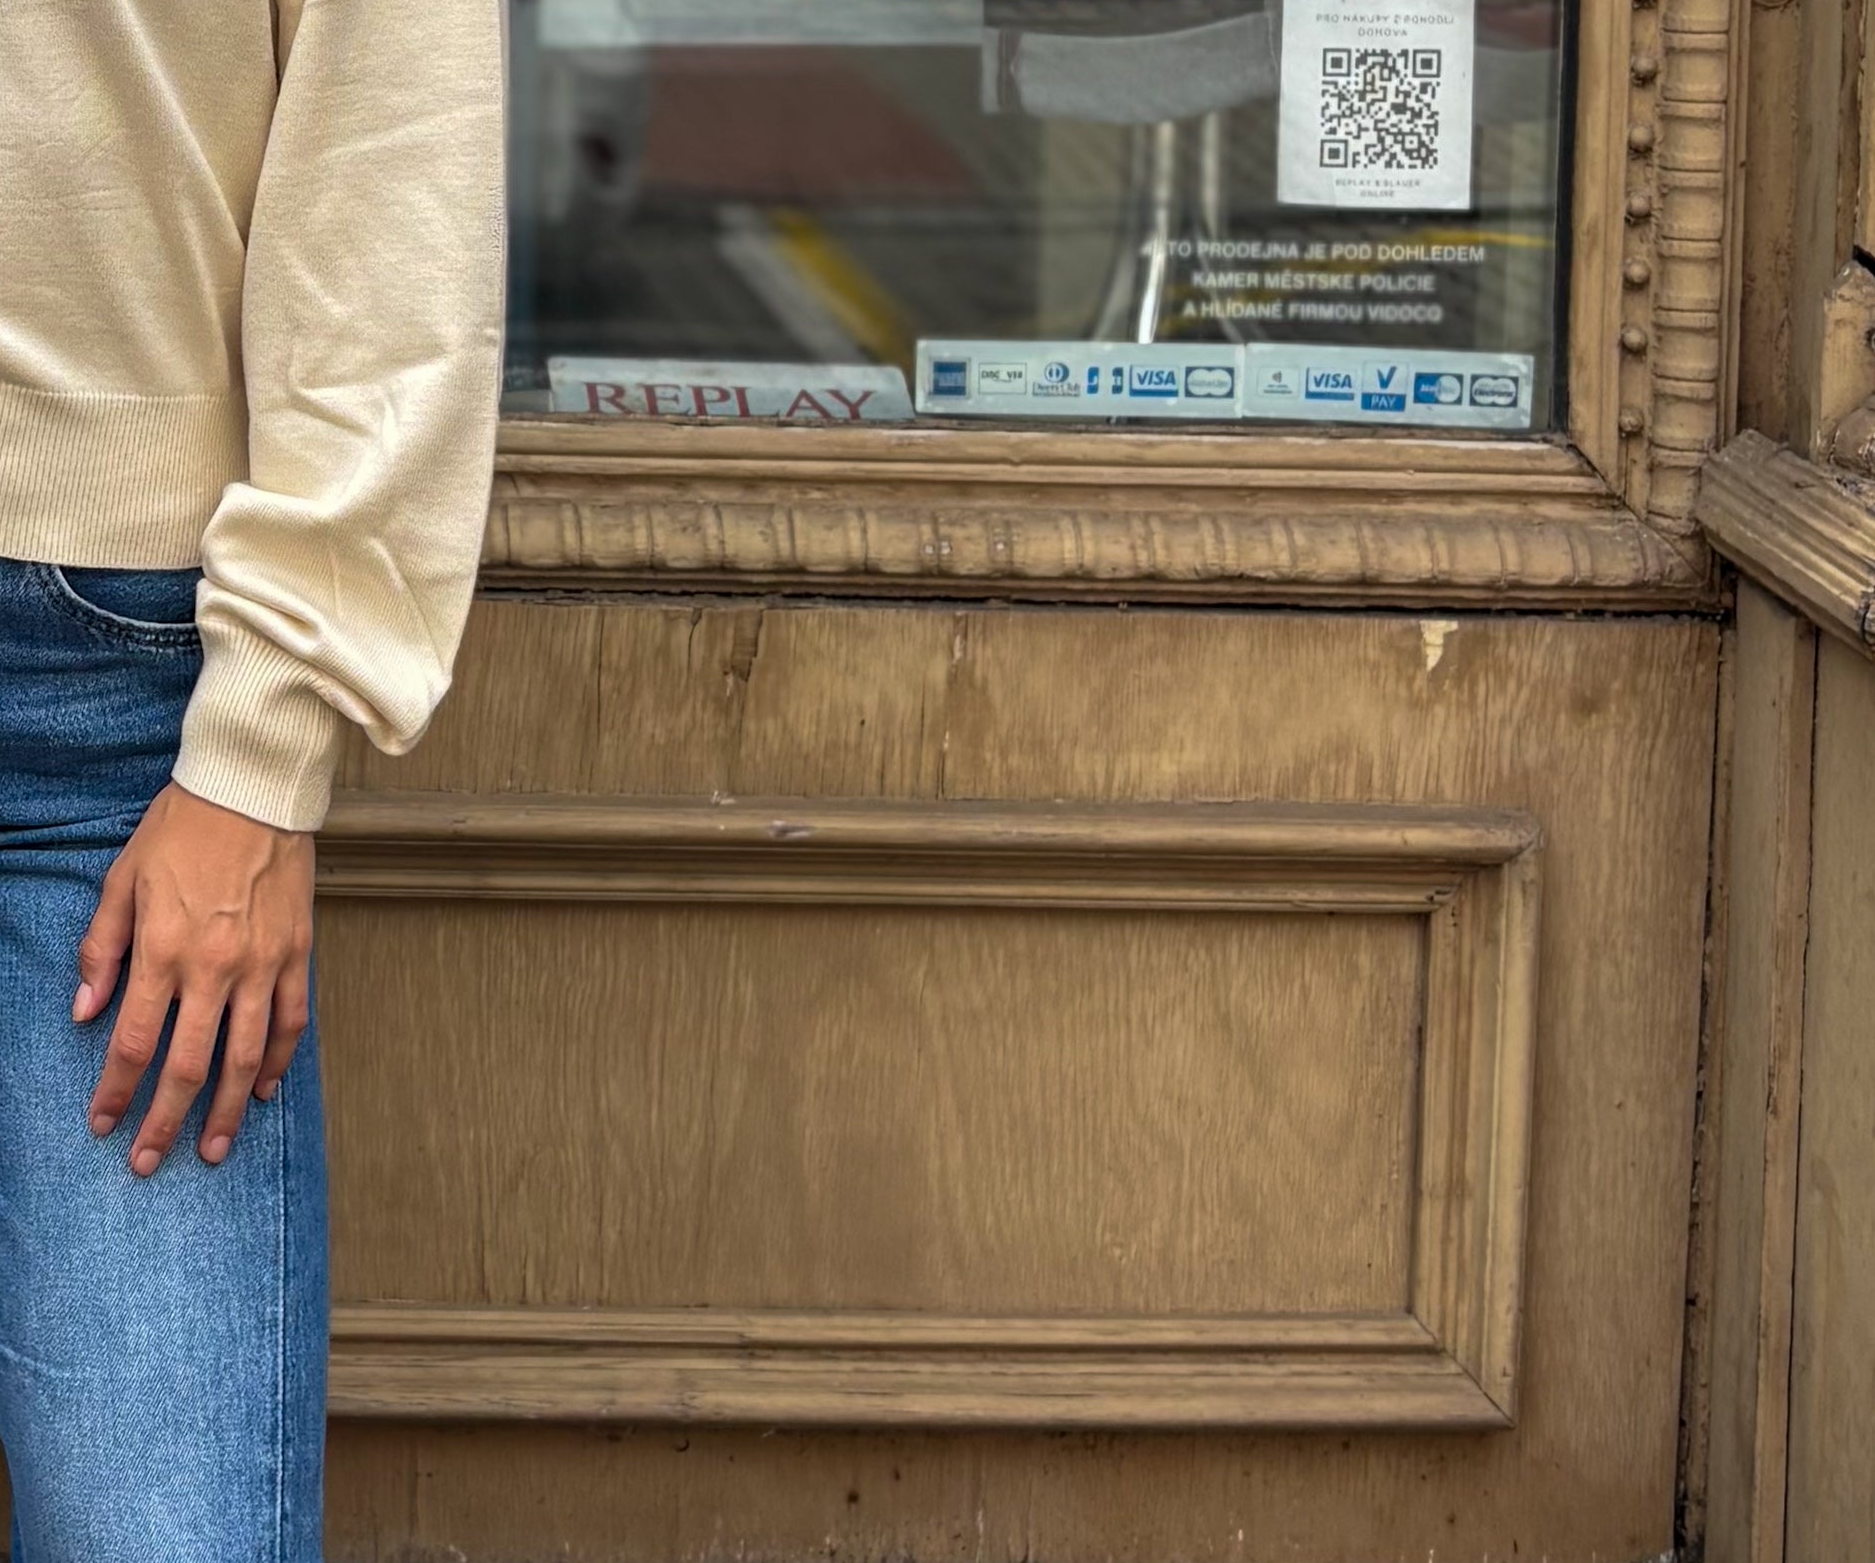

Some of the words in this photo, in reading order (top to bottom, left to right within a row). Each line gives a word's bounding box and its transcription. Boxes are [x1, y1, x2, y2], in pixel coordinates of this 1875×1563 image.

[1197, 240, 1299, 260] PRODEJNA
[1304, 242, 1328, 261] JE
[1332, 243, 1372, 261] POD
[1377, 243, 1485, 263] DOHLEDEM
[1192, 270, 1259, 288] KAMER
[1360, 272, 1436, 293] POLICIE
[1183, 301, 1198, 318] A
[1289, 302, 1363, 321] FIRMOU
[1136, 370, 1177, 386] VISA
[1313, 373, 1353, 388] VISA
[584, 382, 876, 419] REPLAY
[1370, 395, 1397, 408] PAY
